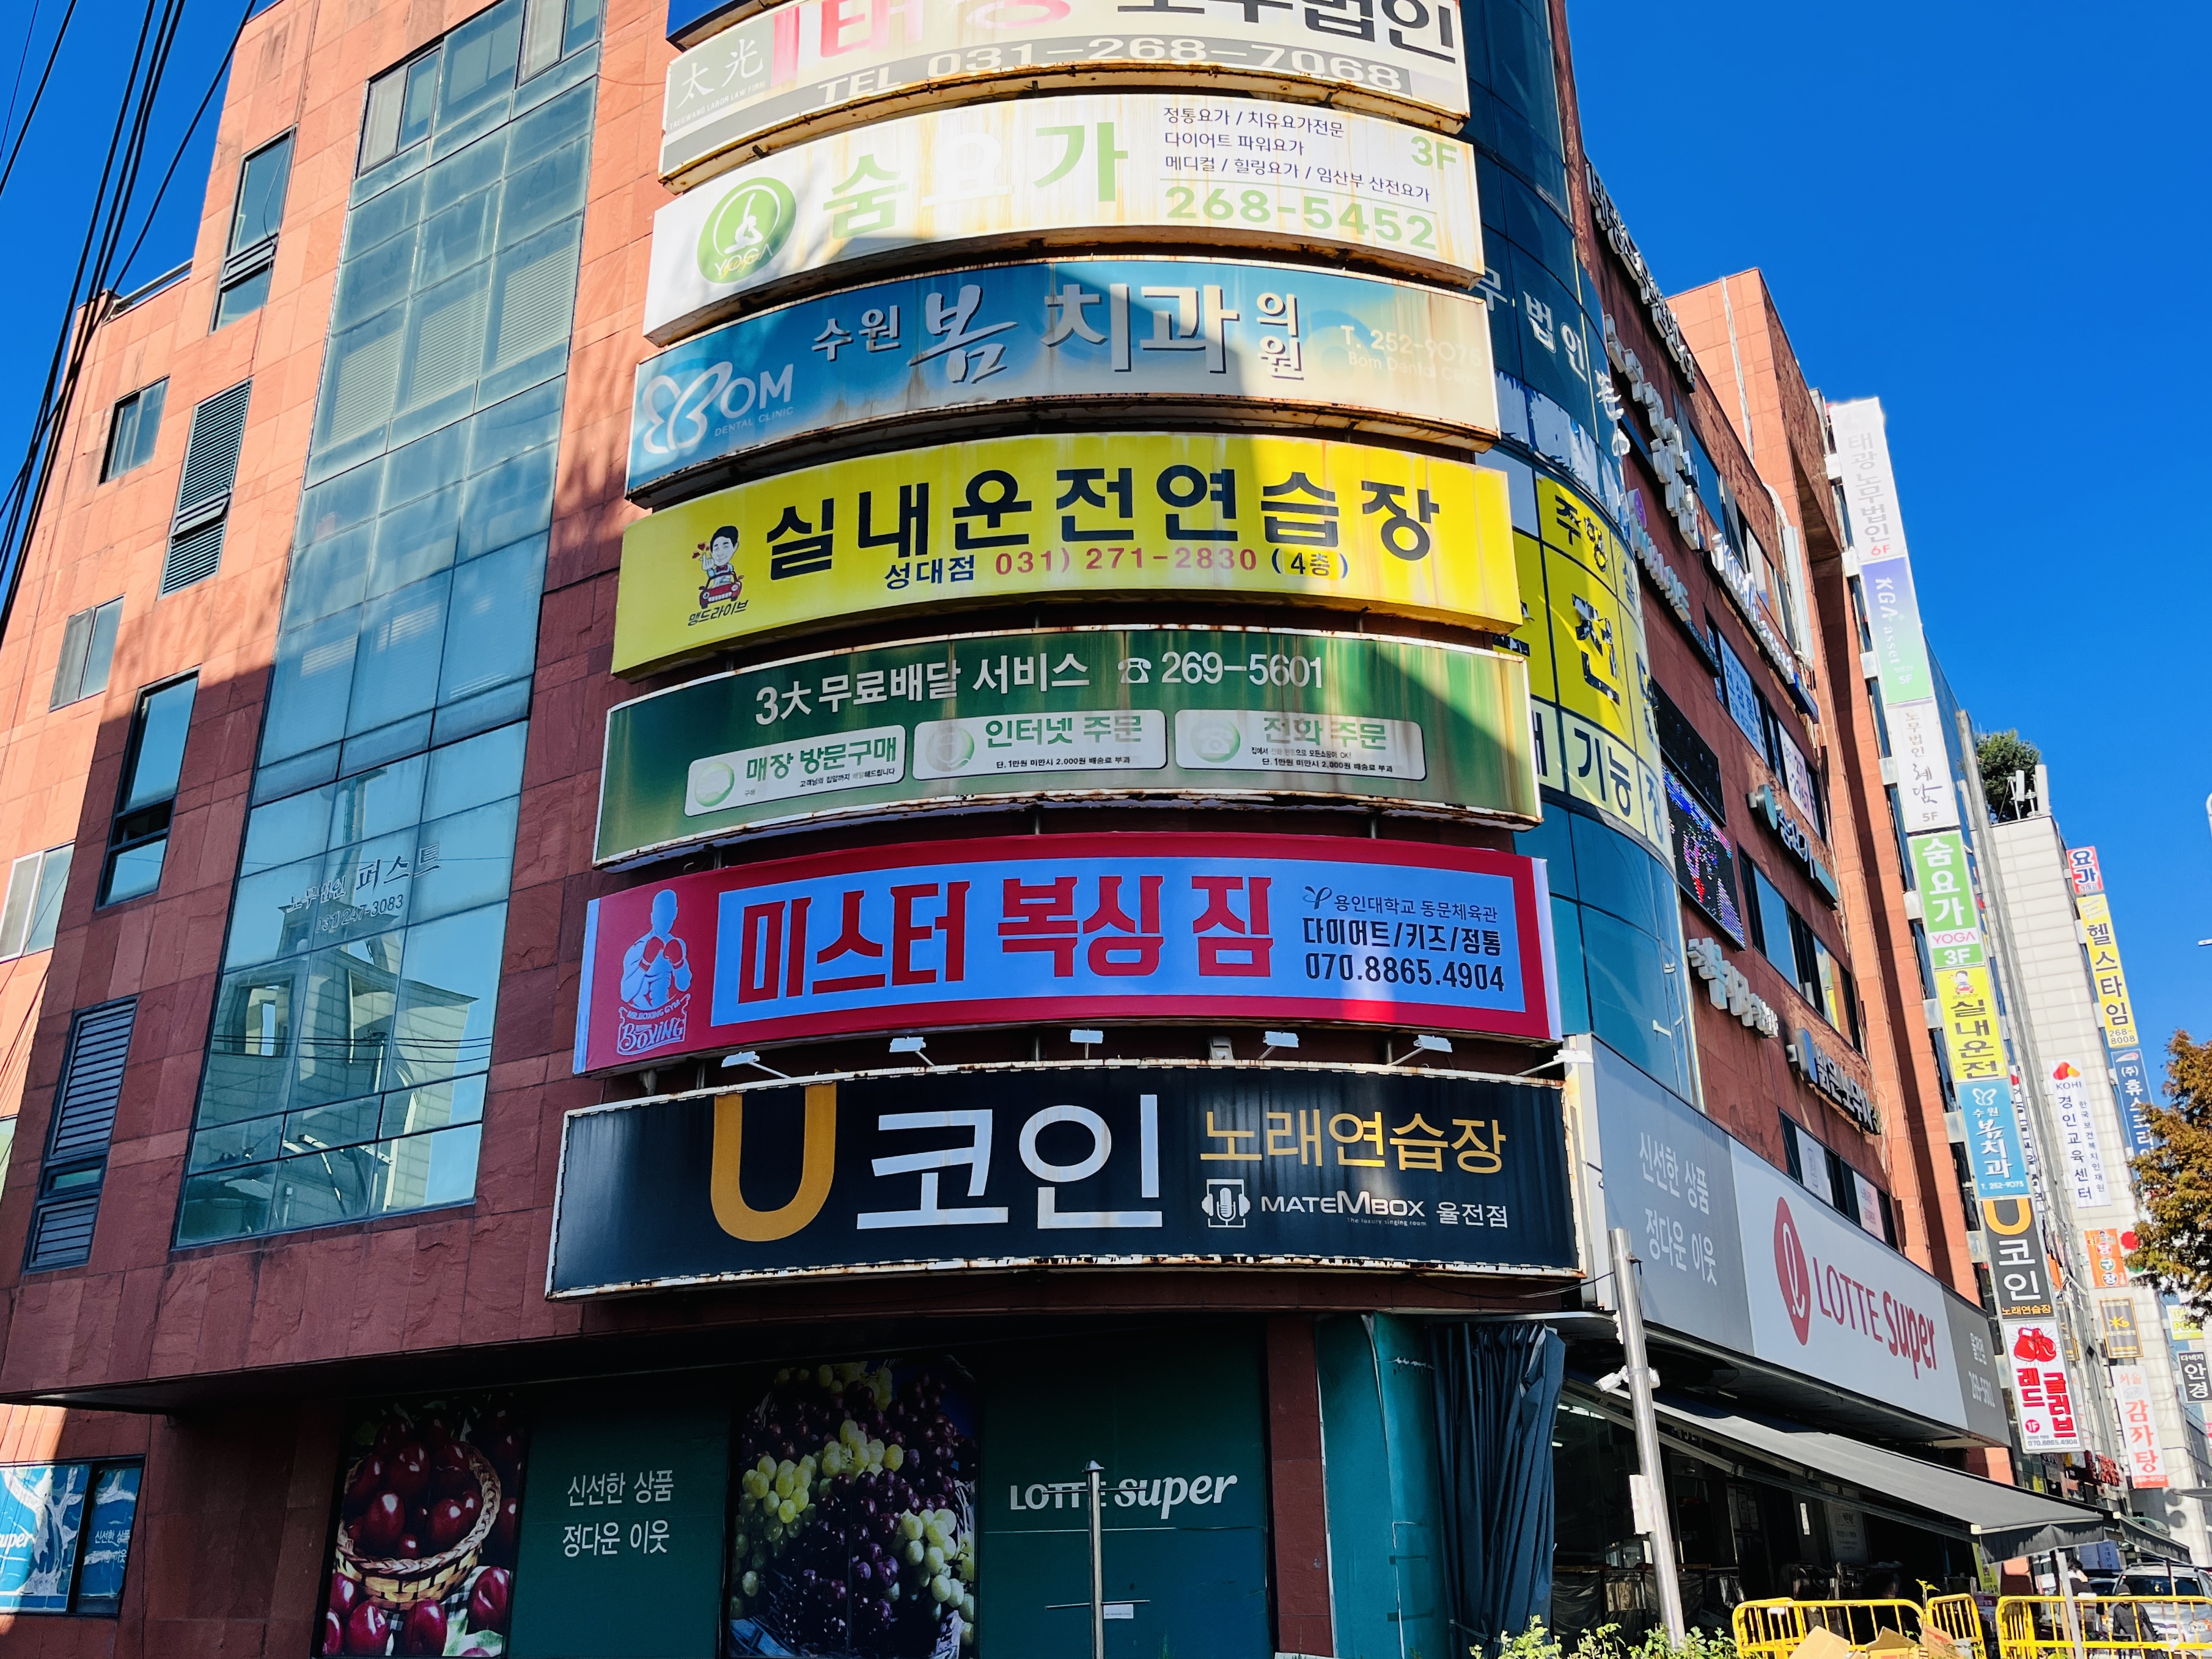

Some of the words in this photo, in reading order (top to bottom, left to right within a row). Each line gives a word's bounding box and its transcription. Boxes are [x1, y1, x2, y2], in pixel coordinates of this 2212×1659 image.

[1117, 0, 1456, 64] 법인
[675, 38, 764, 110] 太光
[818, 66, 901, 105] TEL
[927, 34, 1402, 91] 031-268-7068
[707, 95, 729, 112] LABOR
[730, 89, 747, 101] LAW
[748, 81, 766, 94] FIRM
[1164, 107, 1230, 126] 정통요가
[1247, 111, 1345, 139] 치유요가전문
[1165, 131, 1233, 149] 다이어트
[1237, 136, 1304, 156] 파워요가
[1411, 136, 1458, 171] 3F
[1165, 155, 1216, 173] 메디컬
[1235, 158, 1300, 180] 힐링요가
[1317, 166, 1365, 188] 임산부
[1369, 174, 1430, 203] 산전요가
[1166, 186, 1437, 251] 268-5452
[811, 304, 901, 362] 수원
[1040, 284, 1240, 374] 치과
[1348, 350, 1383, 370] Bom
[1386, 356, 1436, 379] Dental
[714, 418, 754, 438] DENTAL
[758, 405, 795, 424] CLINIC
[1846, 432, 1890, 543] 태광노무법인
[766, 464, 1439, 581] 실내운전연습장
[884, 554, 975, 590] 성대점
[995, 547, 1070, 575] 031)
[1086, 547, 1257, 571] 271-2830
[1870, 544, 1892, 556] 6F
[1883, 625, 1901, 664] asset
[755, 680, 812, 726] 3大
[818, 660, 961, 713] 무료배달
[972, 652, 1090, 695] 서비스
[1161, 650, 1322, 689] 269-5601
[1898, 674, 1913, 685] 5F
[985, 717, 1073, 748] 인터넷
[1083, 715, 1142, 743] 주문
[1263, 716, 1323, 746] 전화
[1331, 721, 1386, 750] 주문
[1905, 712, 1925, 758] 노무법인
[746, 752, 794, 782] 매장
[799, 737, 897, 774] 방문구매
[799, 776, 824, 788] 고객님의
[1922, 811, 1938, 822] 5F
[355, 842, 442, 894] 퍼스트
[1922, 837, 1964, 926] 숨요가
[2073, 850, 2096, 884] 요가
[1334, 894, 1416, 915] 용인대학교
[1420, 900, 1498, 924] 동문체육관
[738, 881, 971, 1004] 미스터
[998, 875, 1164, 977] 복싱
[1191, 875, 1274, 977] 짐
[1931, 931, 1976, 944] YOGA
[1944, 947, 1971, 965] 3F
[1305, 952, 1505, 992] 070.8865.4904
[2087, 922, 2129, 1026] 헬스타임
[1950, 999, 1999, 1080] 실내운전
[2056, 1081, 2082, 1090] KOHI
[1972, 1106, 2000, 1118] 수원
[1200, 1109, 1507, 1174] 노래연습장
[2058, 1095, 2092, 1200] 경인교육센터
[1639, 1131, 1680, 1198] 신선한
[1685, 1160, 1710, 1215] 상품
[1989, 1180, 2024, 1189] 252-9075
[1435, 1201, 1508, 1229] 율전점
[1644, 1208, 1687, 1272] 정다운
[1691, 1232, 1718, 1286] 이웃
[1812, 1256, 1883, 1343] LOTTE
[2002, 1304, 2052, 1315] 노래연습장
[2016, 1367, 2045, 1407] 레드
[2184, 1363, 2208, 1399] 안경
[2043, 1372, 2077, 1438] 글러브
[2026, 1421, 2040, 1432] 1F
[2125, 1399, 2159, 1473] 감자탕
[567, 1472, 626, 1507] 신선한
[634, 1470, 674, 1504] 상품
[1114, 1475, 1238, 1520] super
[562, 1521, 620, 1558] 정다운
[630, 1520, 670, 1554] 이웃
